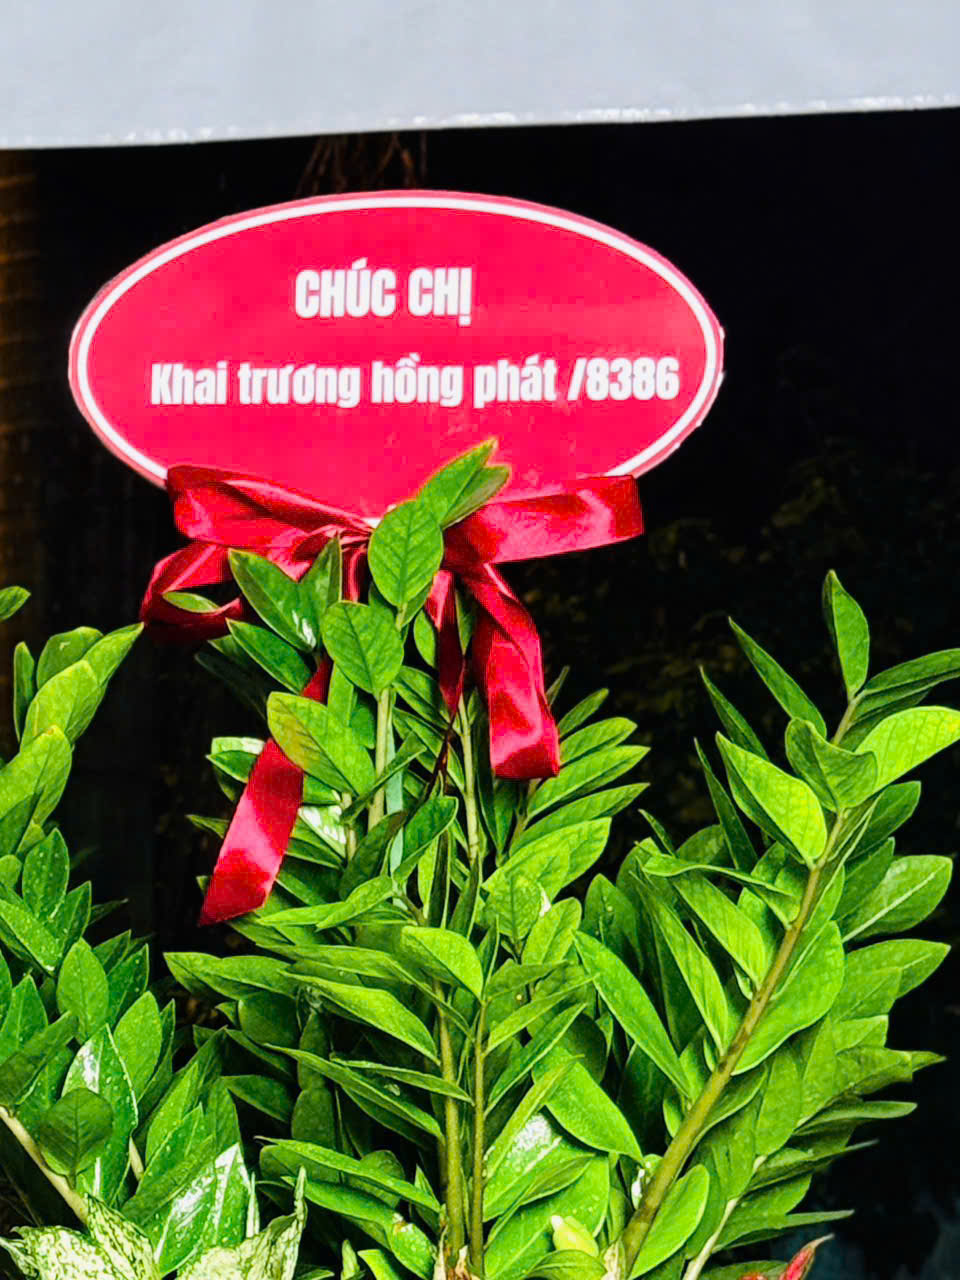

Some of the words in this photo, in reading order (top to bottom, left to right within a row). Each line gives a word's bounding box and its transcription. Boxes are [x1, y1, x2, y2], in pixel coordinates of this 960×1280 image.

[295, 258, 397, 318] CHÚC
[408, 267, 472, 326] CHỊ
[151, 361, 228, 405] Khai
[237, 362, 361, 409] trương
[371, 353, 463, 408] hồng
[474, 354, 557, 409] phát
[567, 356, 680, 401] /8386
